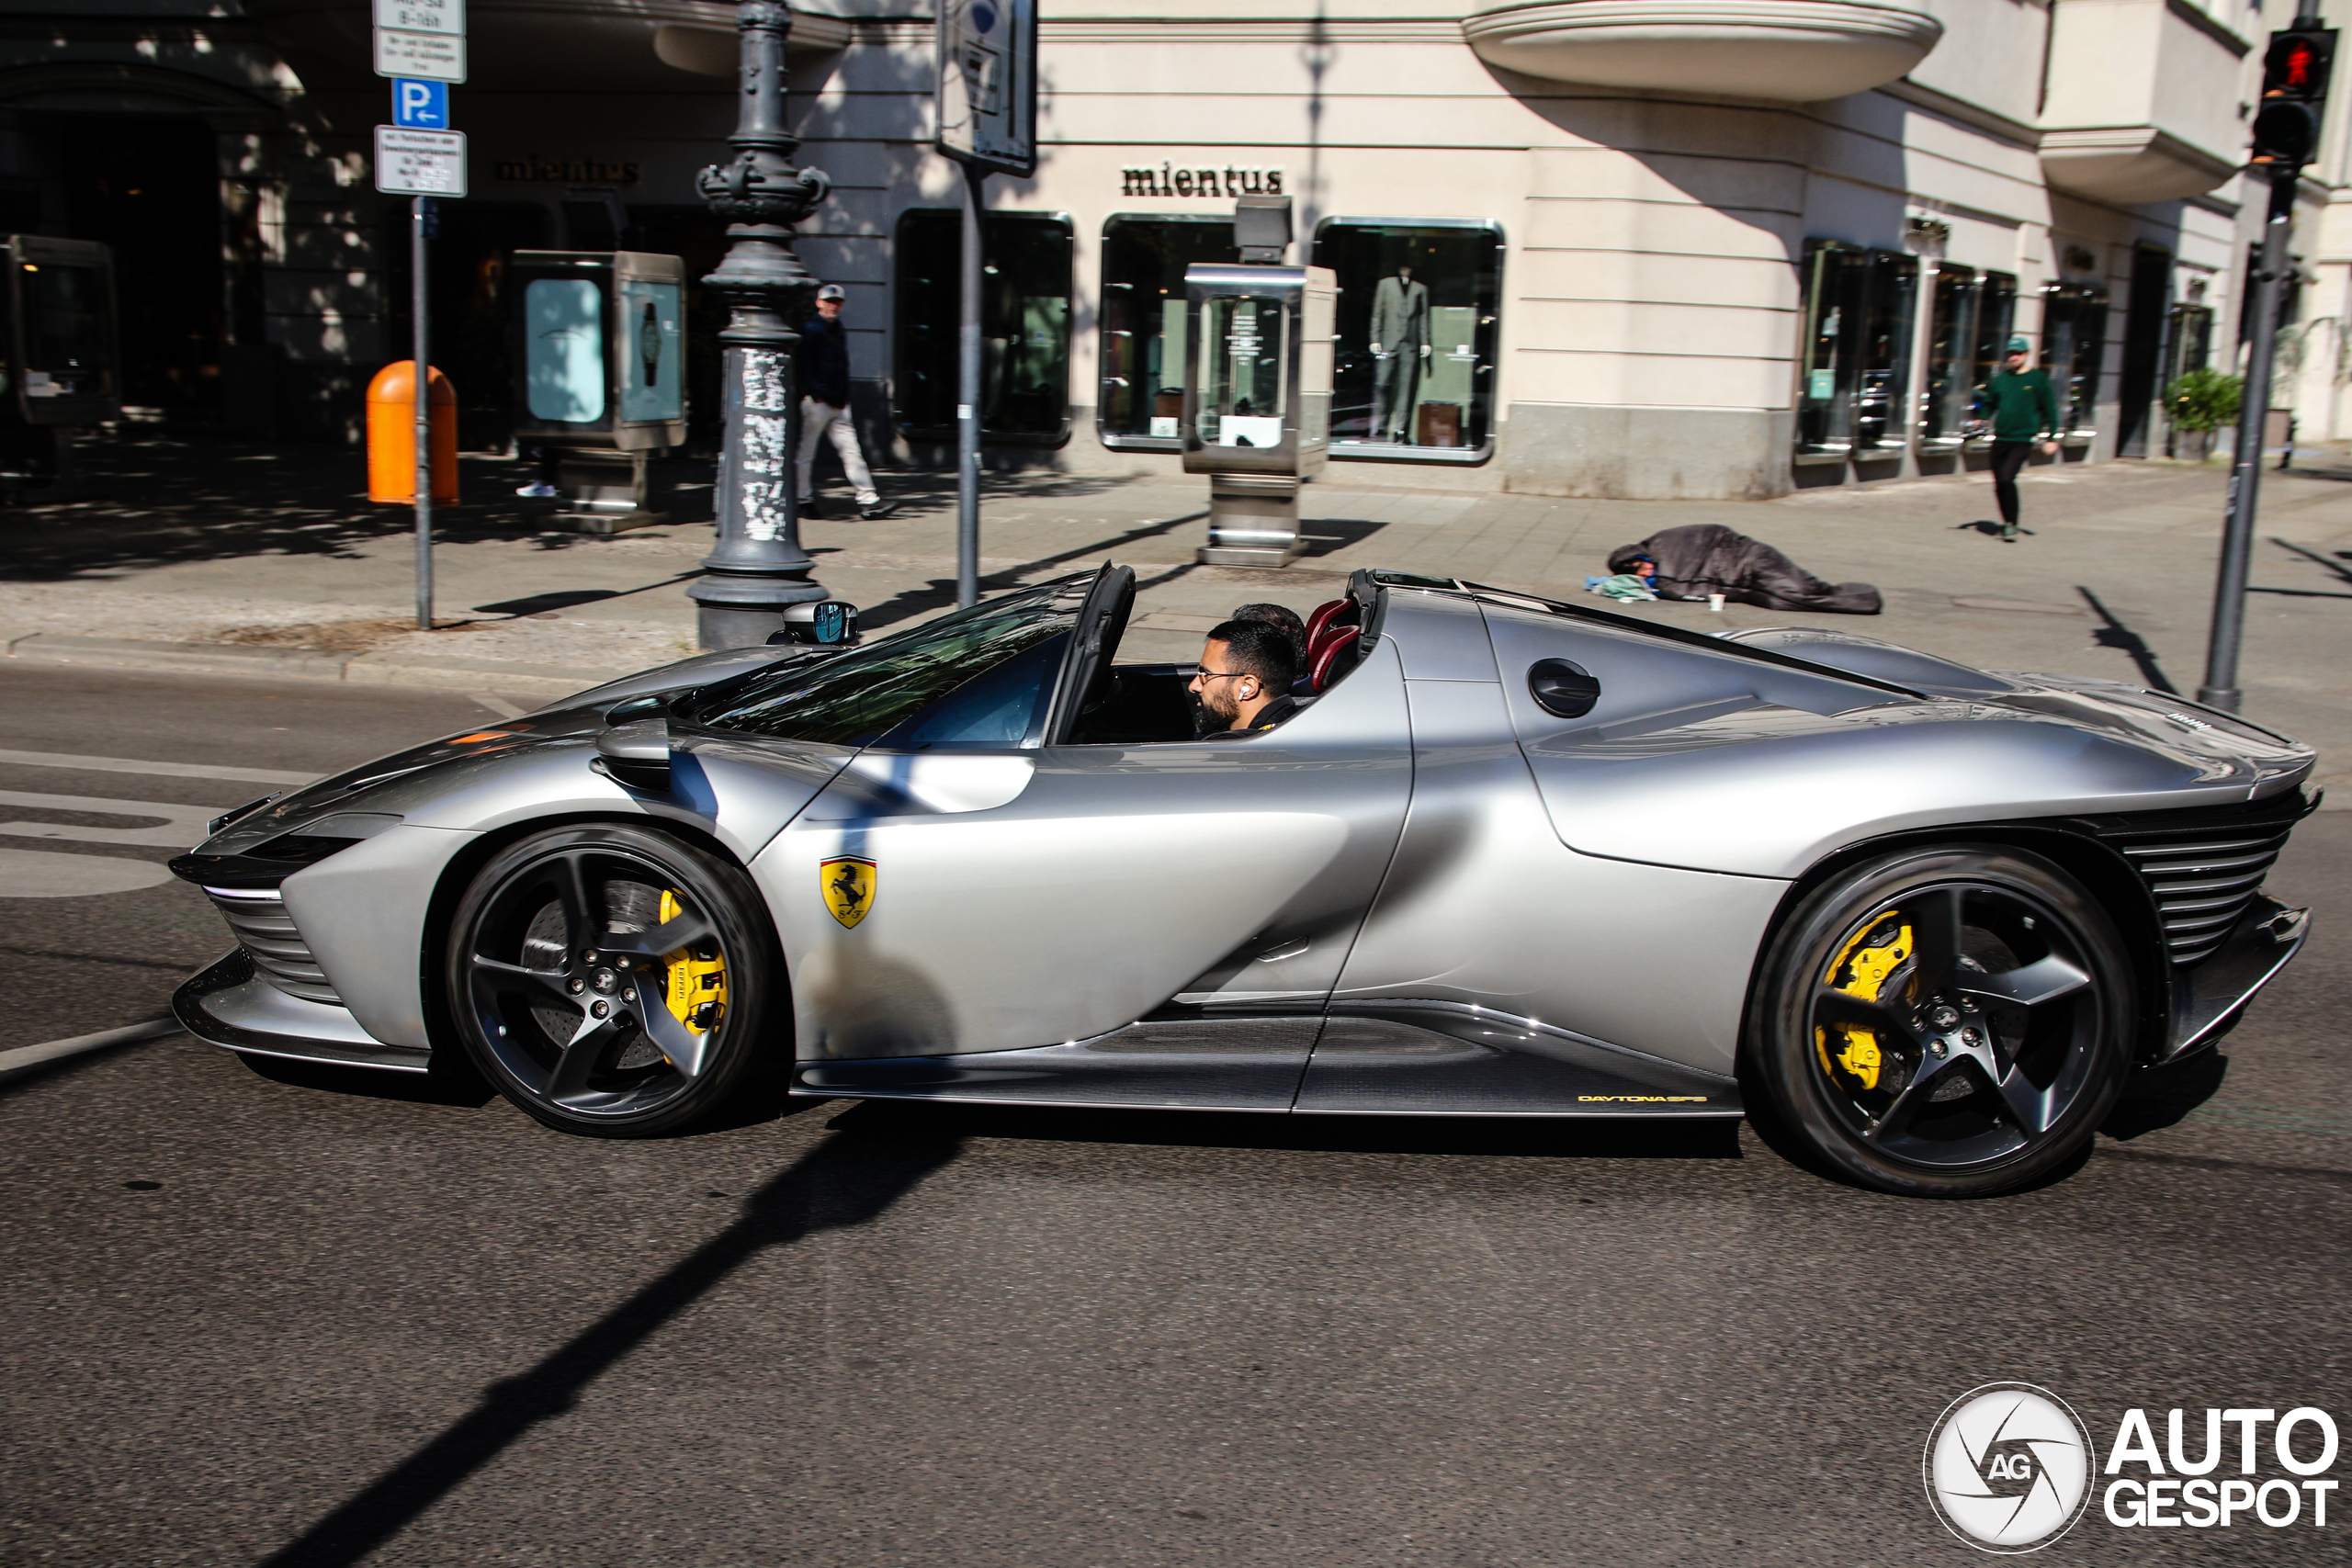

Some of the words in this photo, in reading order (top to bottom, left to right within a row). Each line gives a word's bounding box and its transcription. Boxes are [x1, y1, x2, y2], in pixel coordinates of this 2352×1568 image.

[401, 82, 432, 121] P
[494, 153, 639, 183] mientus
[1120, 159, 1283, 194] mientus
